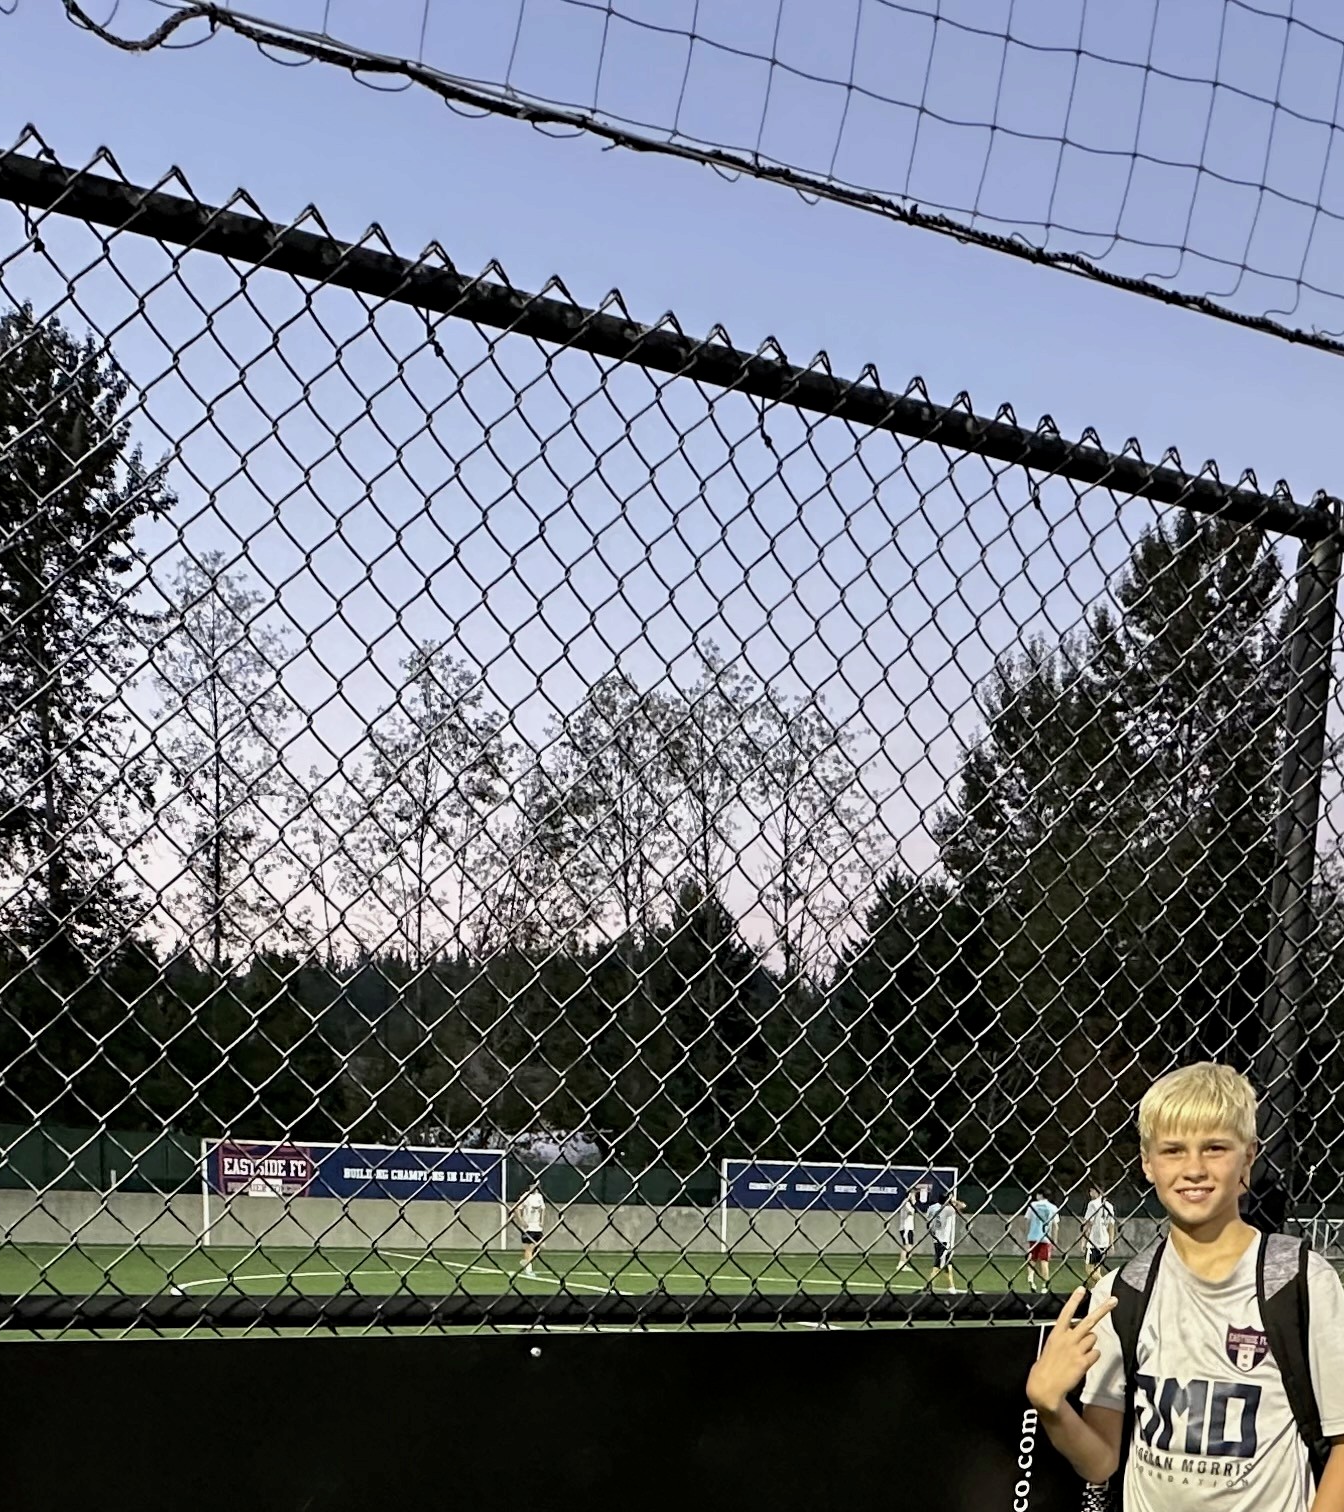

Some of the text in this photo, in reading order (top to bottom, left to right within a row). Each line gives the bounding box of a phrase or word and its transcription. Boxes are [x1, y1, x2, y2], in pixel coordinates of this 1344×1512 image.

[223, 1158, 307, 1177] EASTSIDE FC
[343, 1168, 388, 1180] BUILDNG
[391, 1170, 444, 1182] CHAMPINS
[460, 1172, 481, 1183] LIFE
[1182, 1458, 1255, 1478] MORRIS
